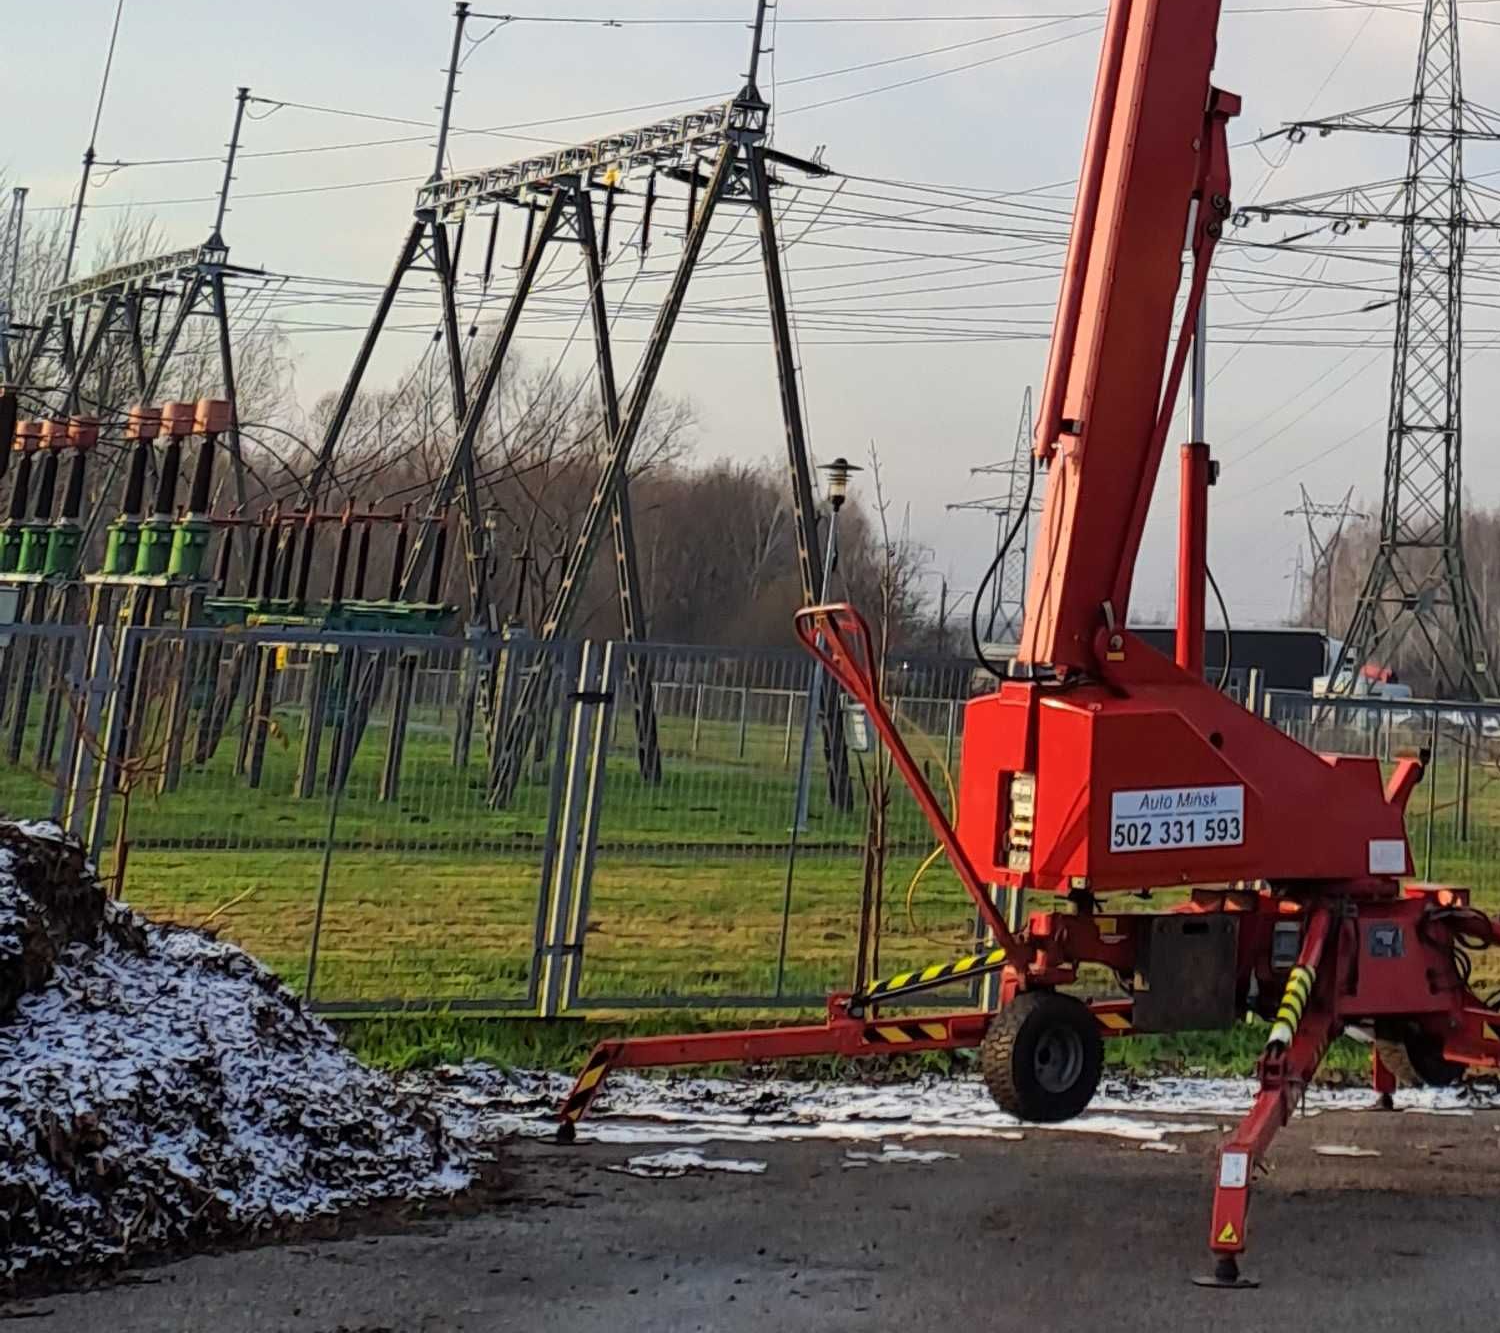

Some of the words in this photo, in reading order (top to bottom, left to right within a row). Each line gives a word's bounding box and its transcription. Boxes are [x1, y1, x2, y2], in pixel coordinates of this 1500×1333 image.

[1139, 793, 1173, 812] Auto
[1113, 821, 1152, 848] 502
[1159, 819, 1195, 844] 331
[1204, 817, 1241, 842] 593
